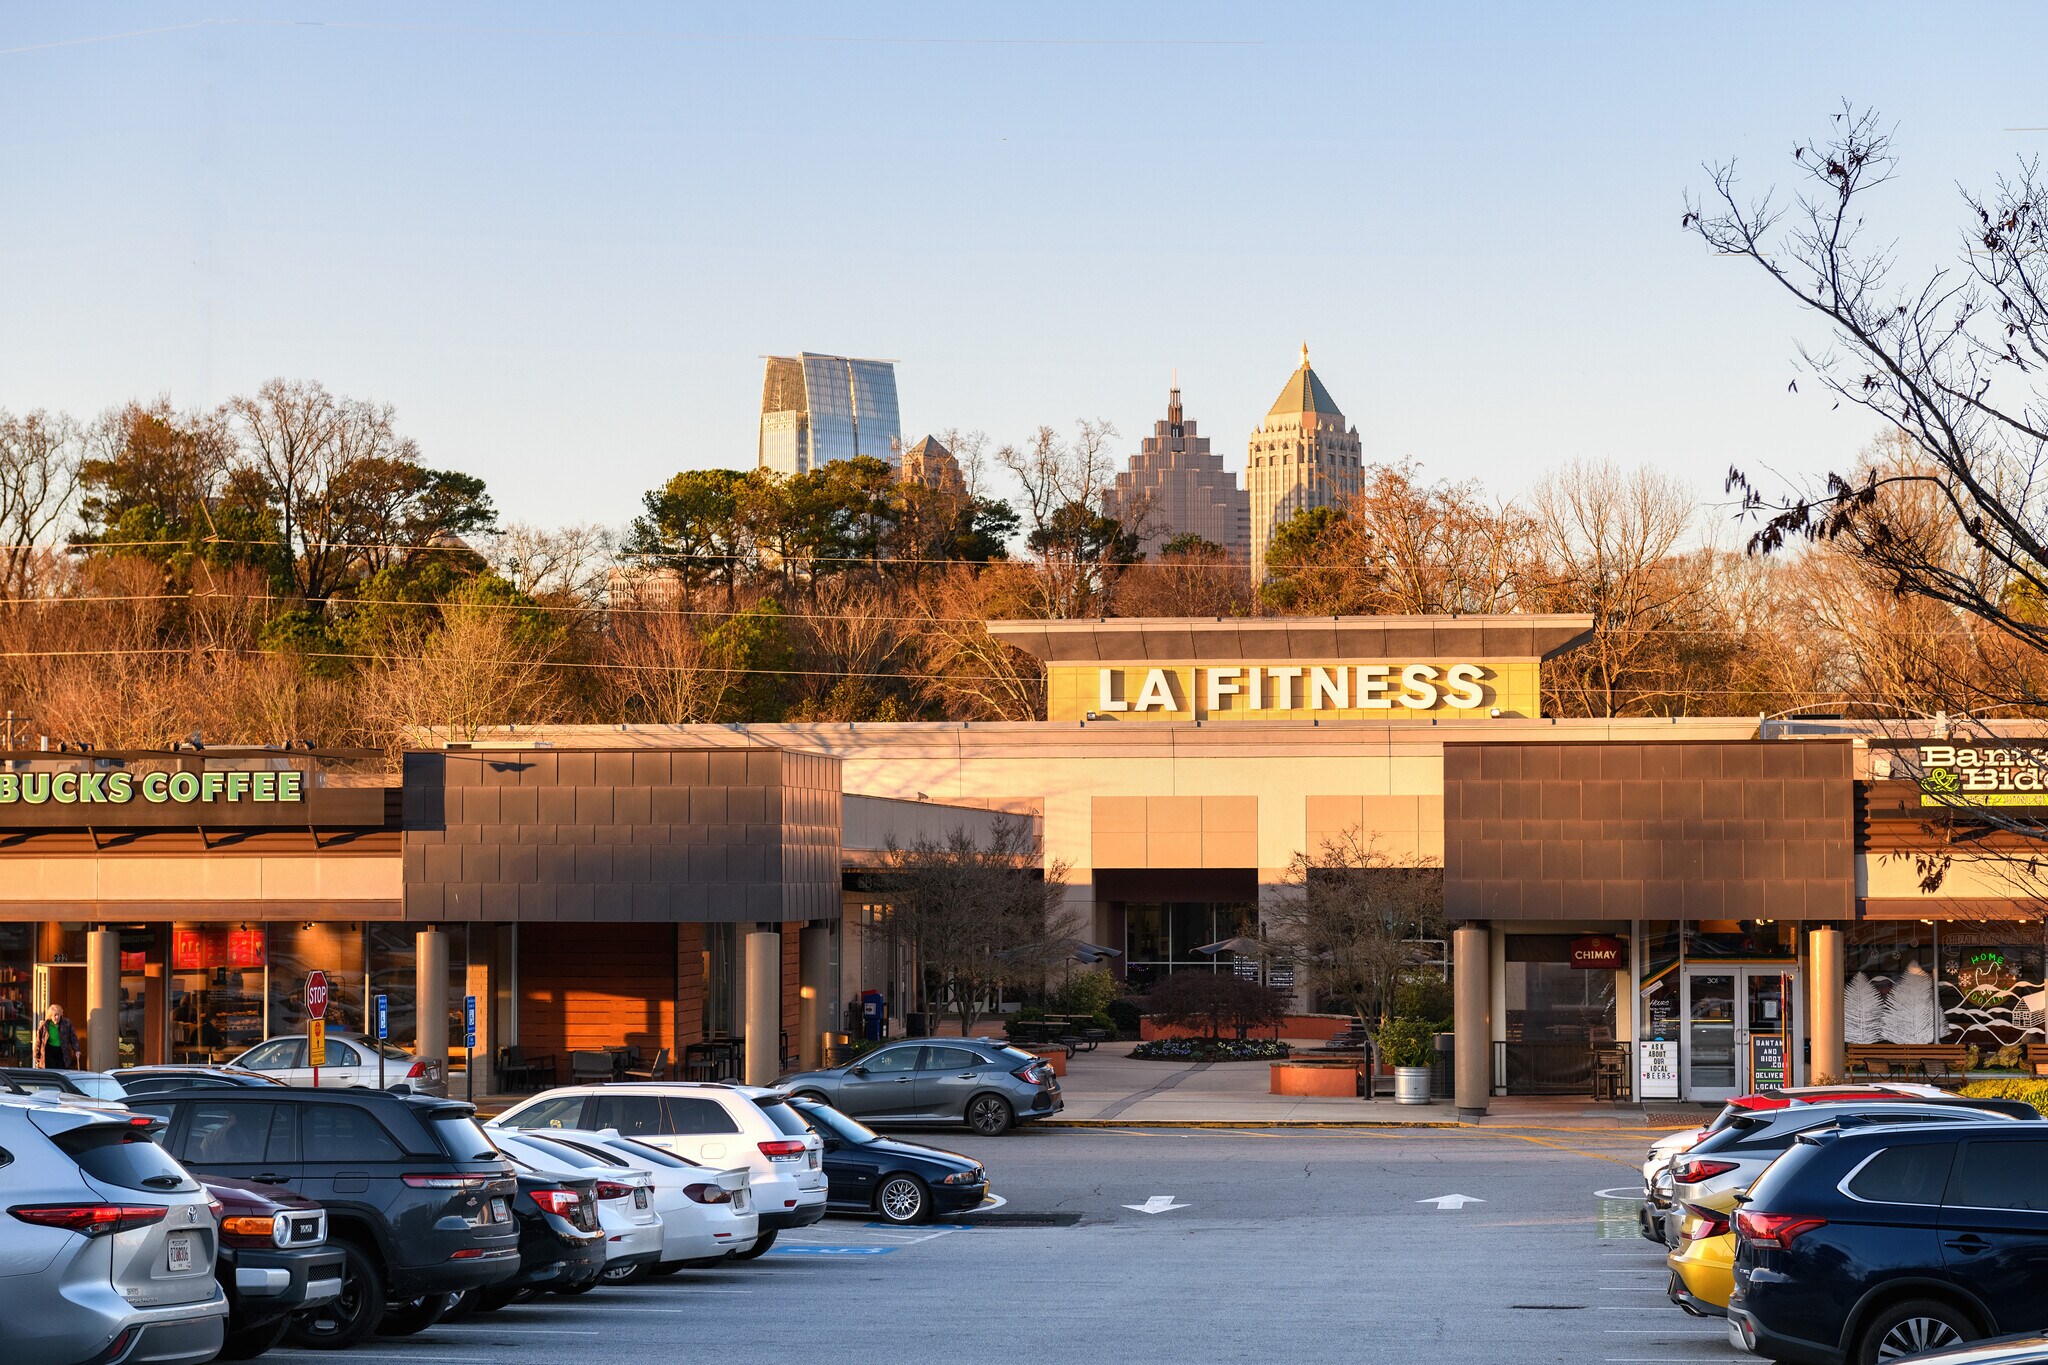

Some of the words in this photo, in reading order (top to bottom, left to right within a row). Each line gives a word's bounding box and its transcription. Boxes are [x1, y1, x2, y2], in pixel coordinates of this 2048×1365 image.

[1100, 668, 1178, 711] LA
[1207, 663, 1485, 711] FITNESS
[142, 771, 301, 803] COFFEE
[1962, 767, 2048, 791] Bid
[54, 954, 67, 962] 232
[1574, 950, 1618, 960] CHIMAY
[1970, 953, 2005, 965] HOME
[309, 986, 327, 1005] STOP
